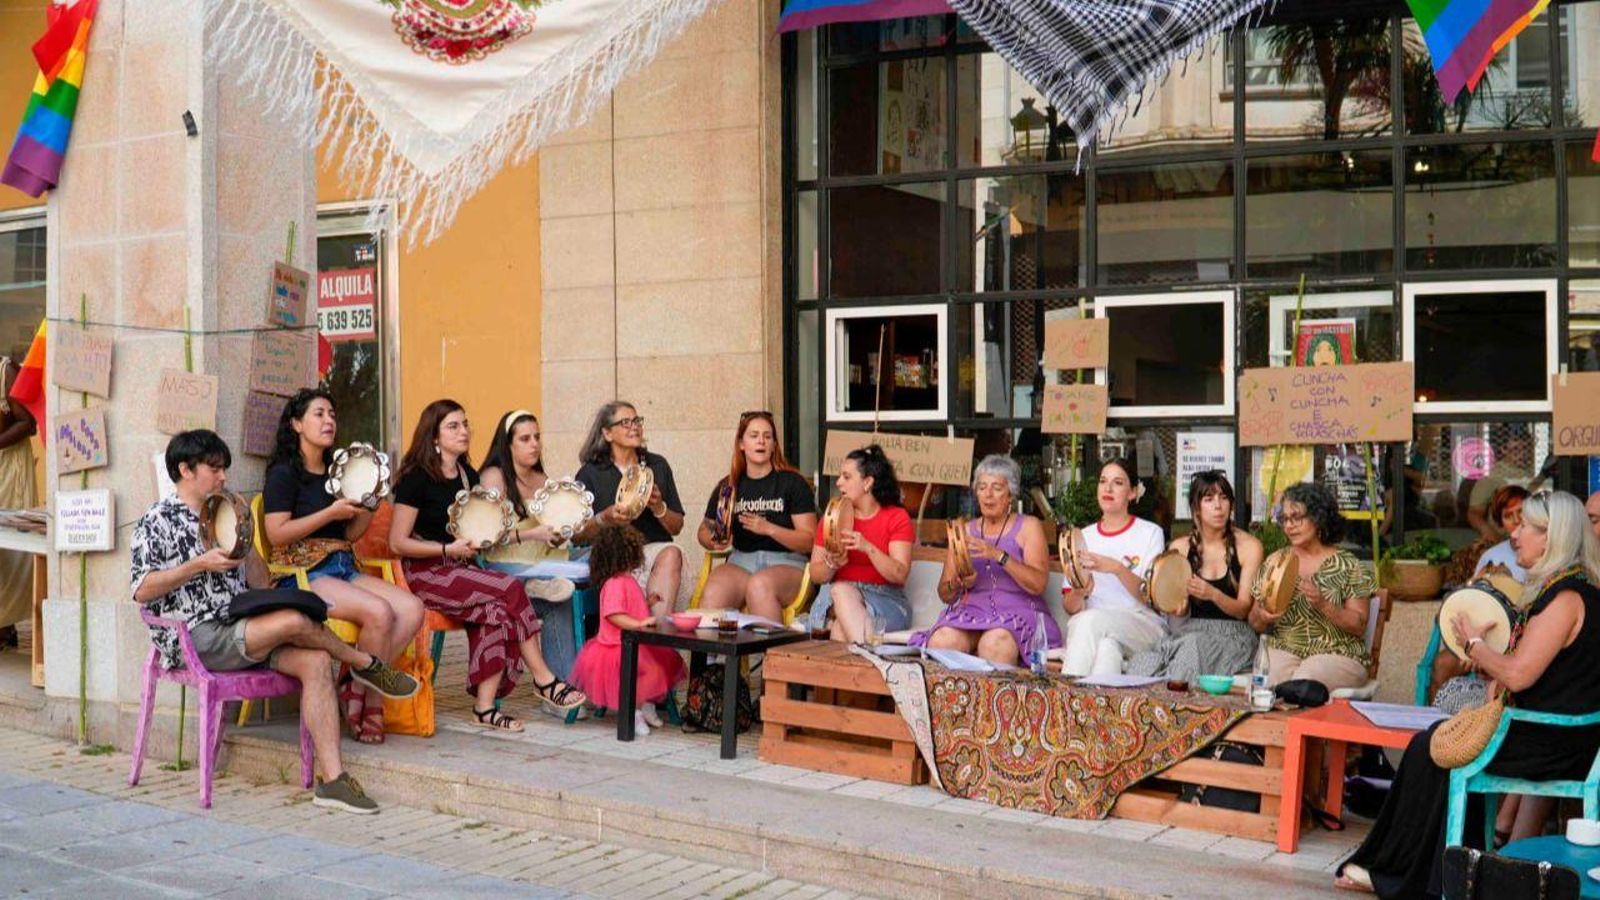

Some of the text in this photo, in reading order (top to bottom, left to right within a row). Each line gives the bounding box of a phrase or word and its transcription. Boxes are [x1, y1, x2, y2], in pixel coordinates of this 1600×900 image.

[321, 273, 373, 302] ALQUILA
[327, 311, 348, 330] 639
[352, 309, 372, 328] 525
[1293, 372, 1348, 388] CUNCHA
[1309, 387, 1336, 397] CON
[905, 437, 930, 454] BEN
